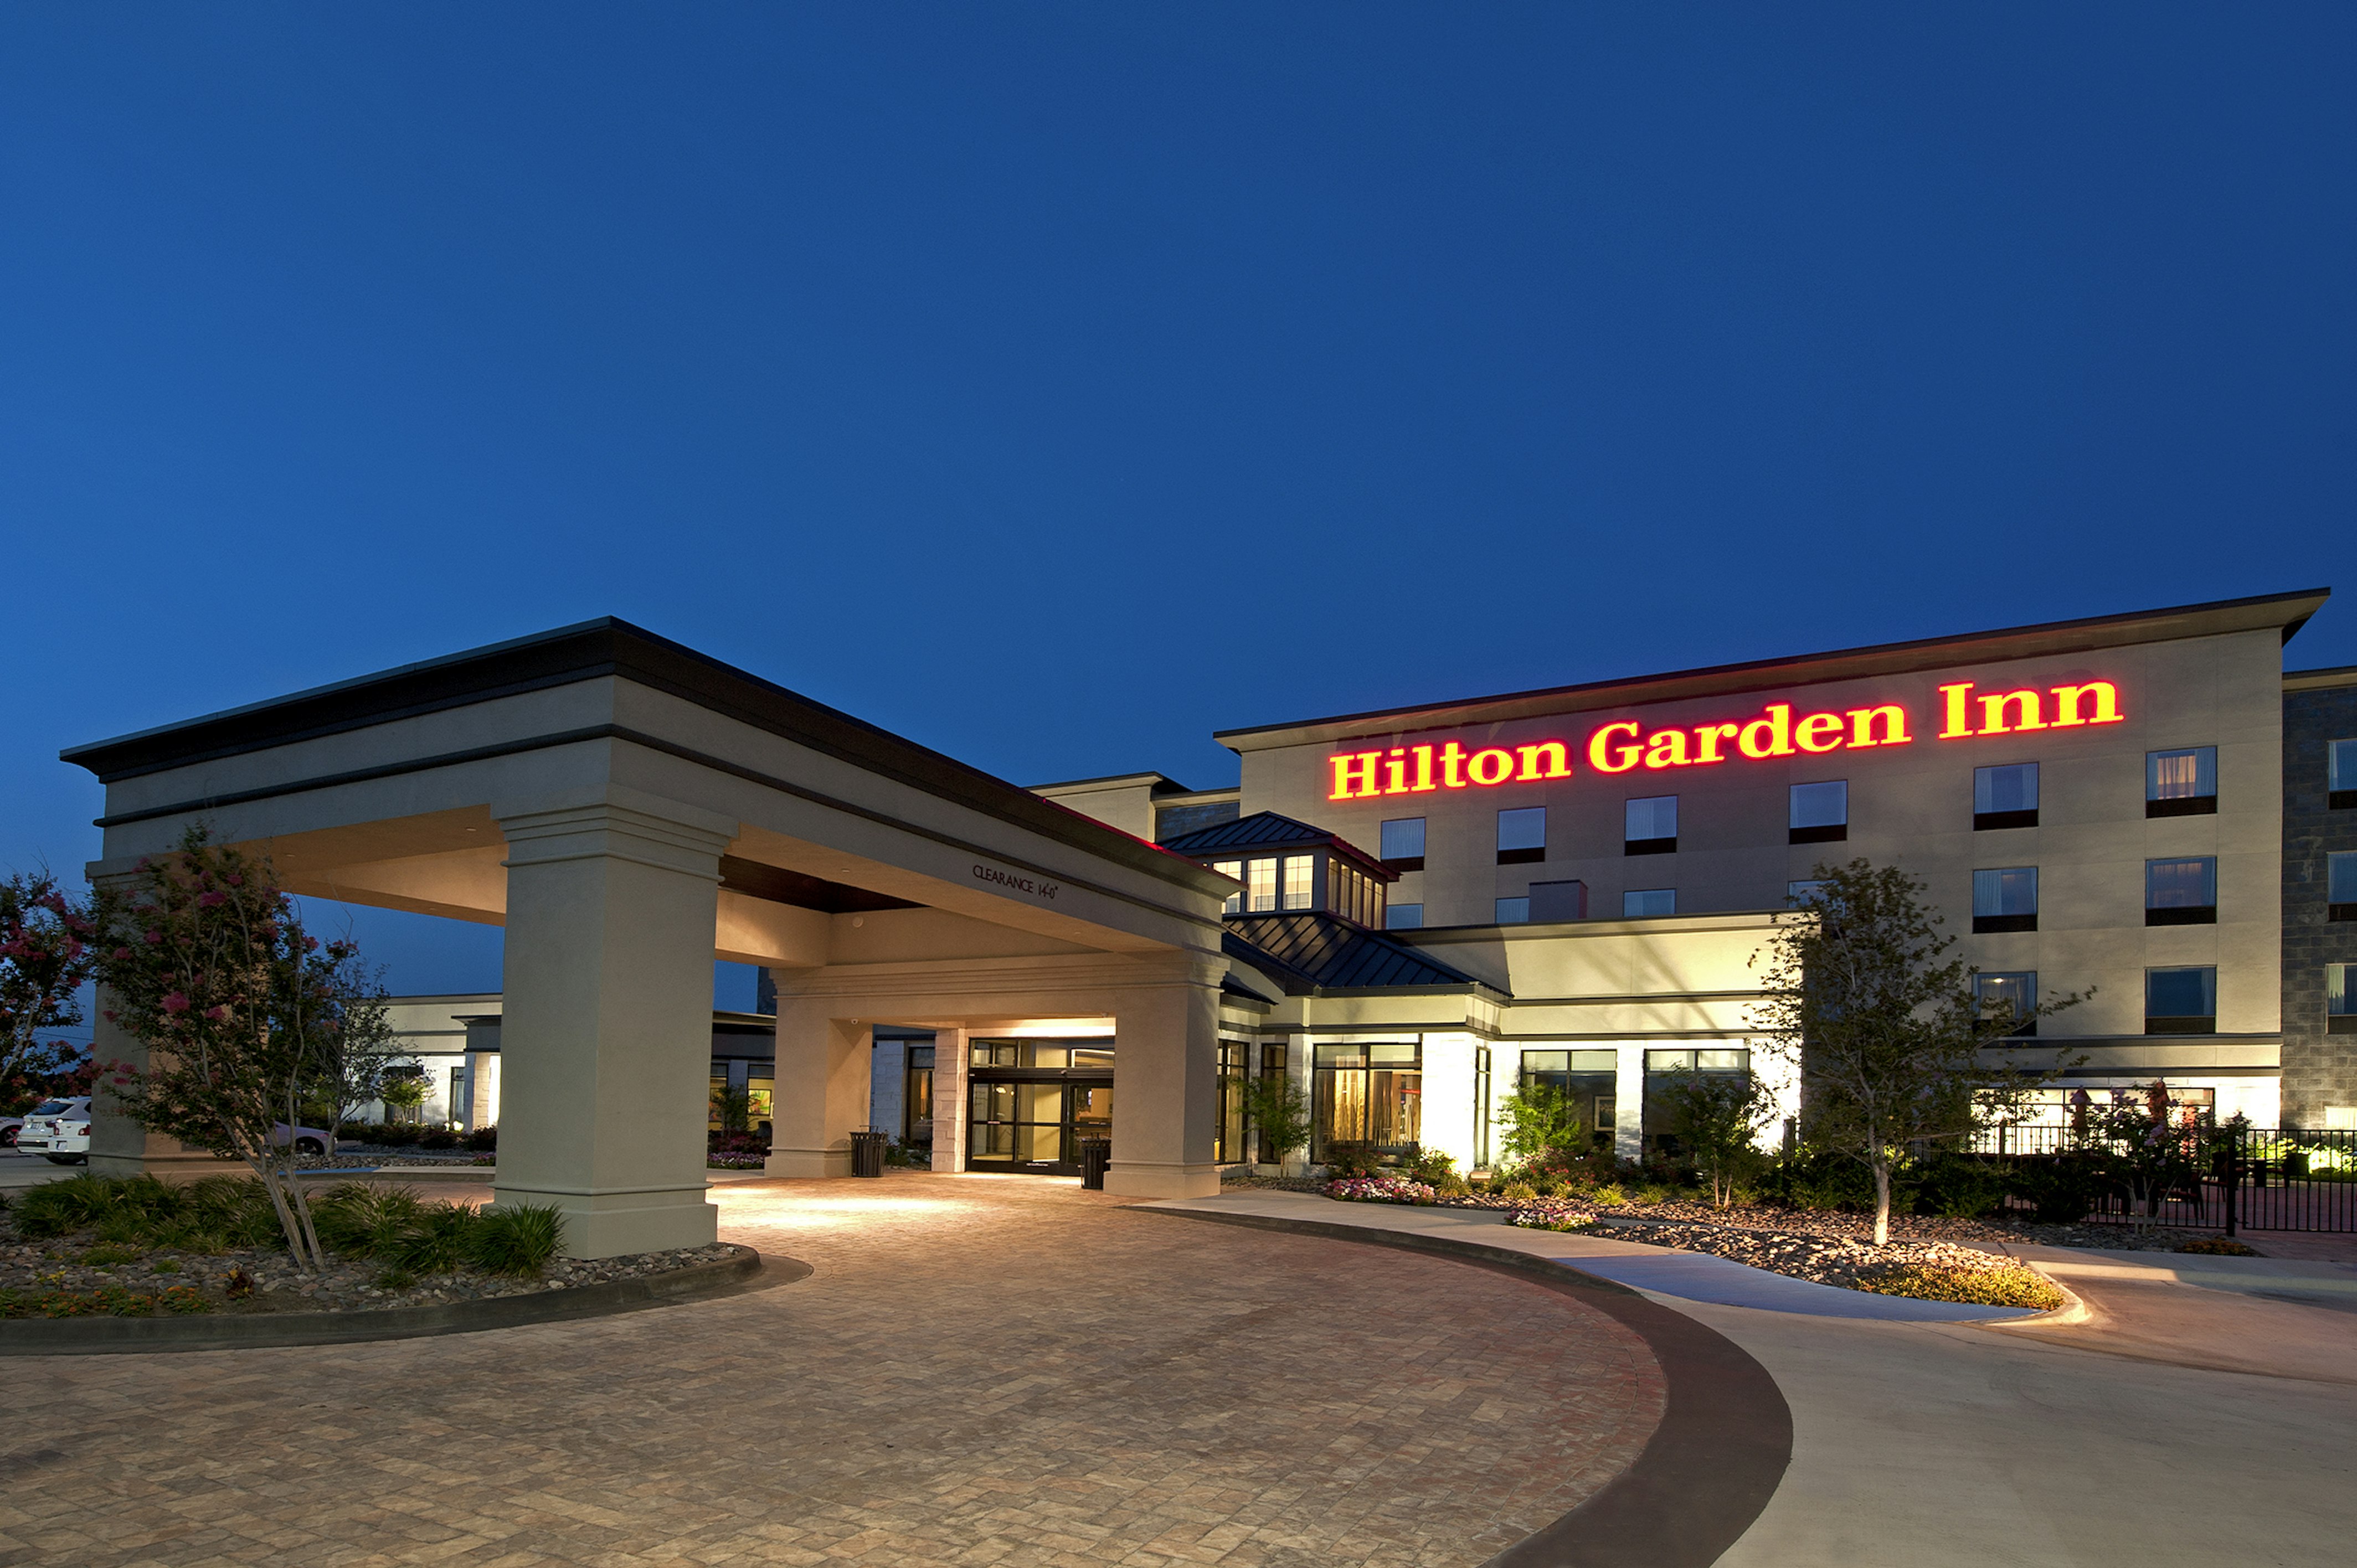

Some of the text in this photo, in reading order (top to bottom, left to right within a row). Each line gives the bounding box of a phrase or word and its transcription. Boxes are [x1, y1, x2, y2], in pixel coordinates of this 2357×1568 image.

[1328, 681, 2125, 801] Hilton Garden Inn
[973, 865, 1033, 894] CLEARANCE
